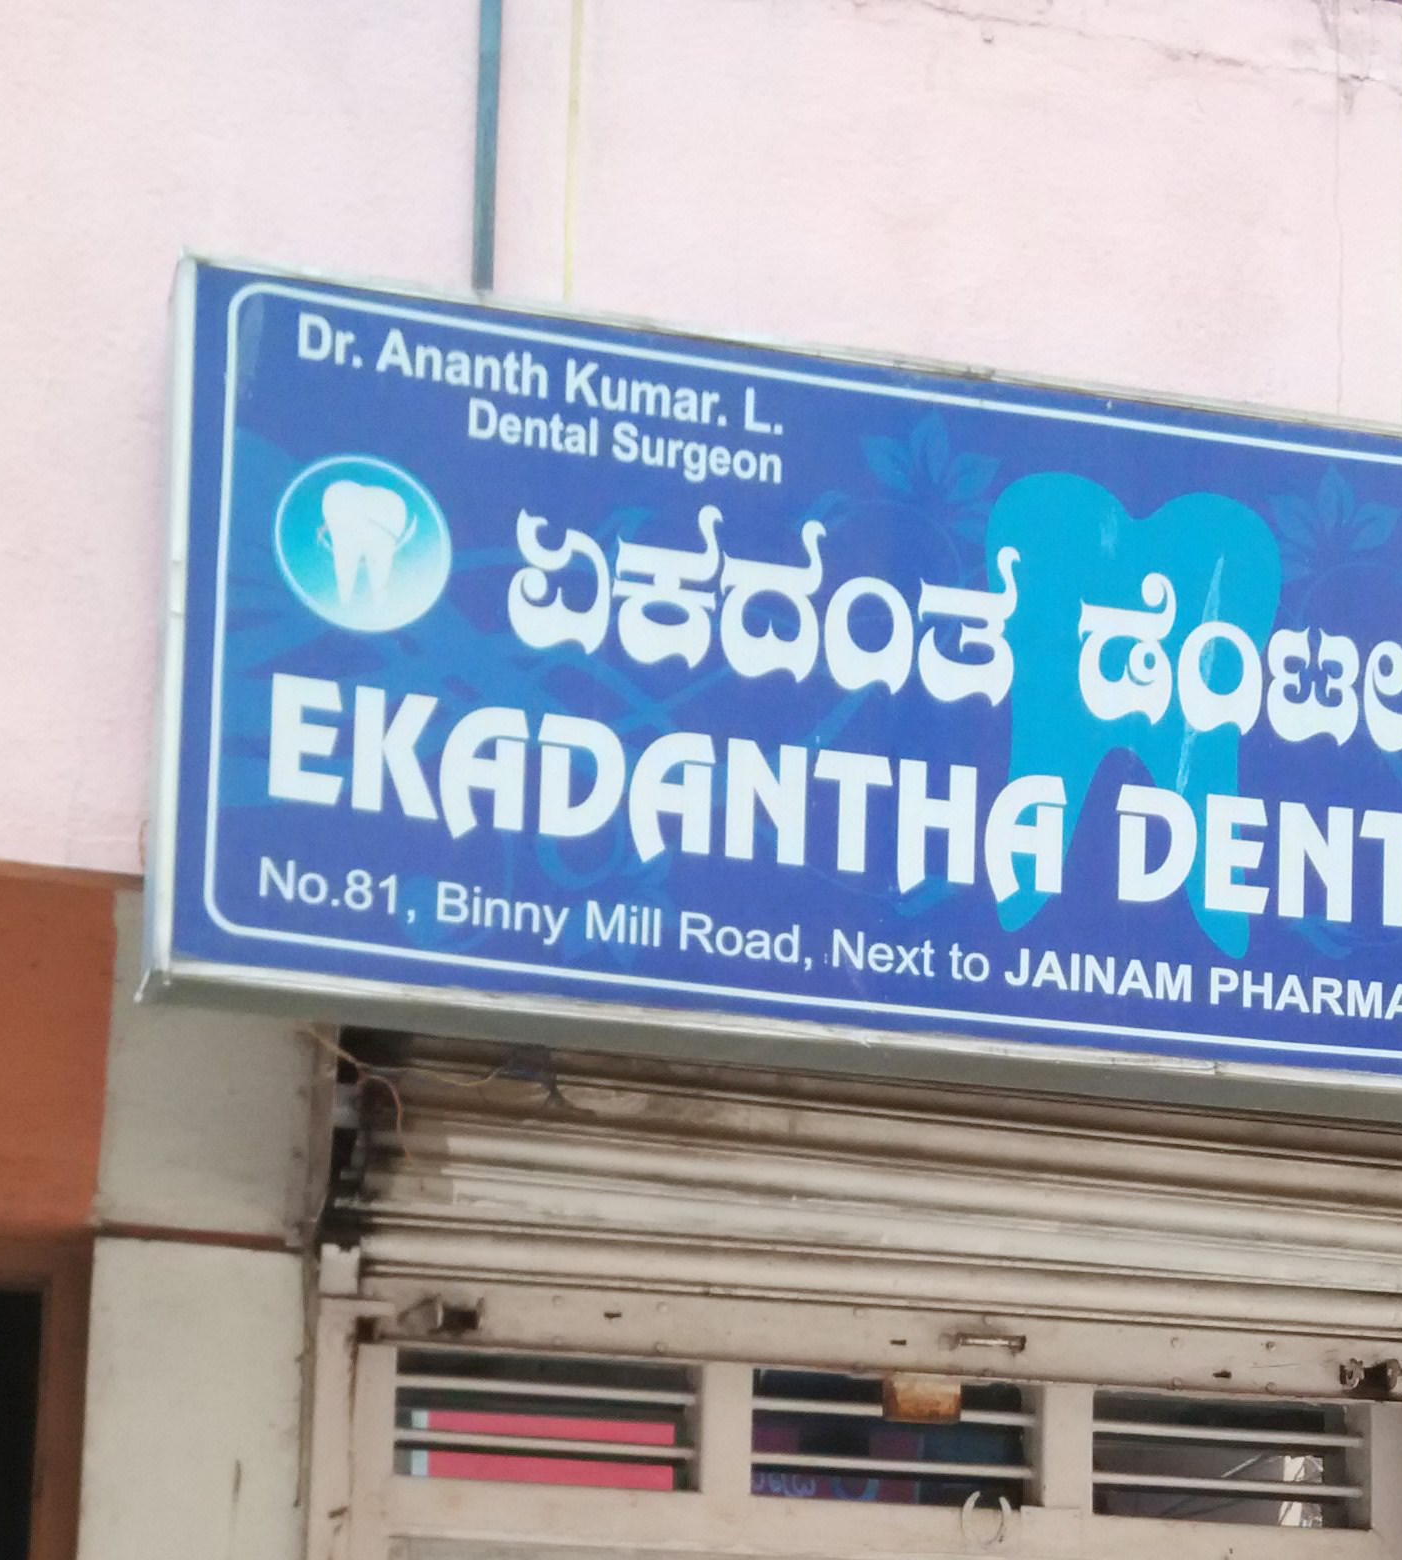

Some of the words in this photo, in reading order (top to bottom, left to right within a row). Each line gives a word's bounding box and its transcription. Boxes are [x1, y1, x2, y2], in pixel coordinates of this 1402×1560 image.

[299, 313, 362, 368] Dr.
[376, 329, 547, 398] Ananth
[566, 359, 726, 426] Kumar.
[745, 388, 782, 435] L.
[468, 398, 598, 456] Dental
[613, 424, 782, 483] Surgeon
[508, 505, 1019, 706] ಏಕದಂತ
[268, 671, 1067, 904] EKADANTHA
[260, 857, 415, 925] No.81,
[437, 882, 569, 945] Binny
[586, 901, 661, 947] Mill
[680, 912, 811, 971] Road,
[833, 929, 934, 977] Next
[949, 943, 989, 982] to
[1005, 948, 1191, 1002] JAINAM
